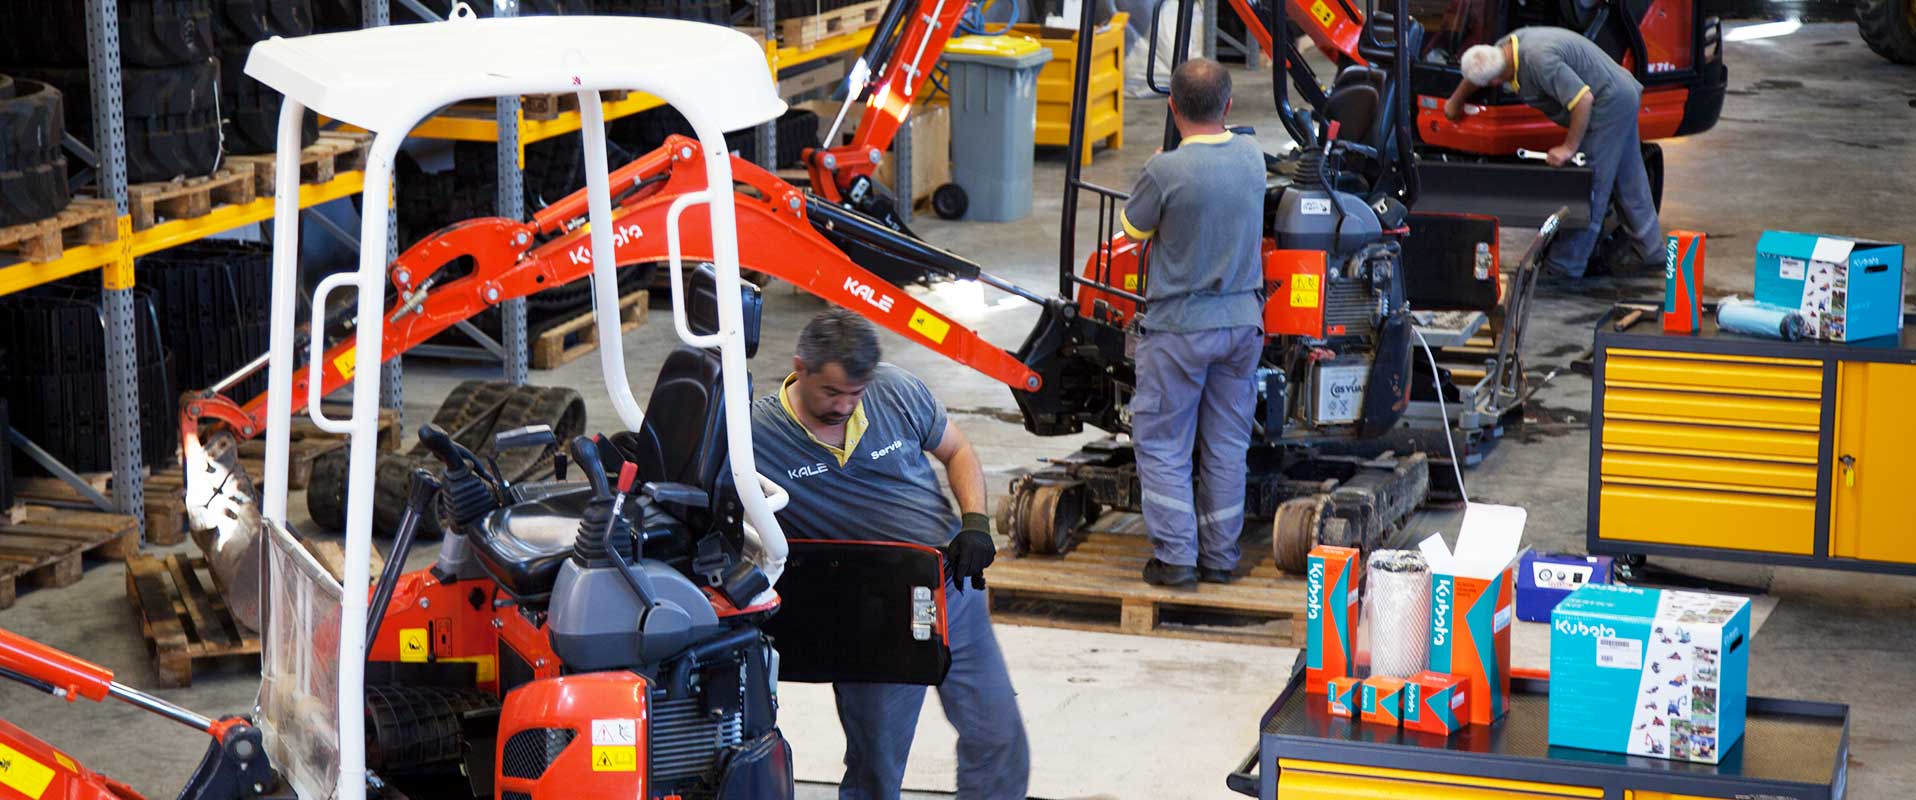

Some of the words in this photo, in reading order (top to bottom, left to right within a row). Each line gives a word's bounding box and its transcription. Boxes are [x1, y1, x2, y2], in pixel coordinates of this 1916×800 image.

[568, 224, 643, 265] Kota
[1666, 239, 1678, 279] Kubota
[843, 276, 895, 313] KALE
[870, 440, 903, 460] Servis
[787, 462, 829, 480] KALE
[1308, 562, 1324, 620] Kubota
[1433, 579, 1451, 646] Kubota
[1555, 618, 1616, 639] Kubota
